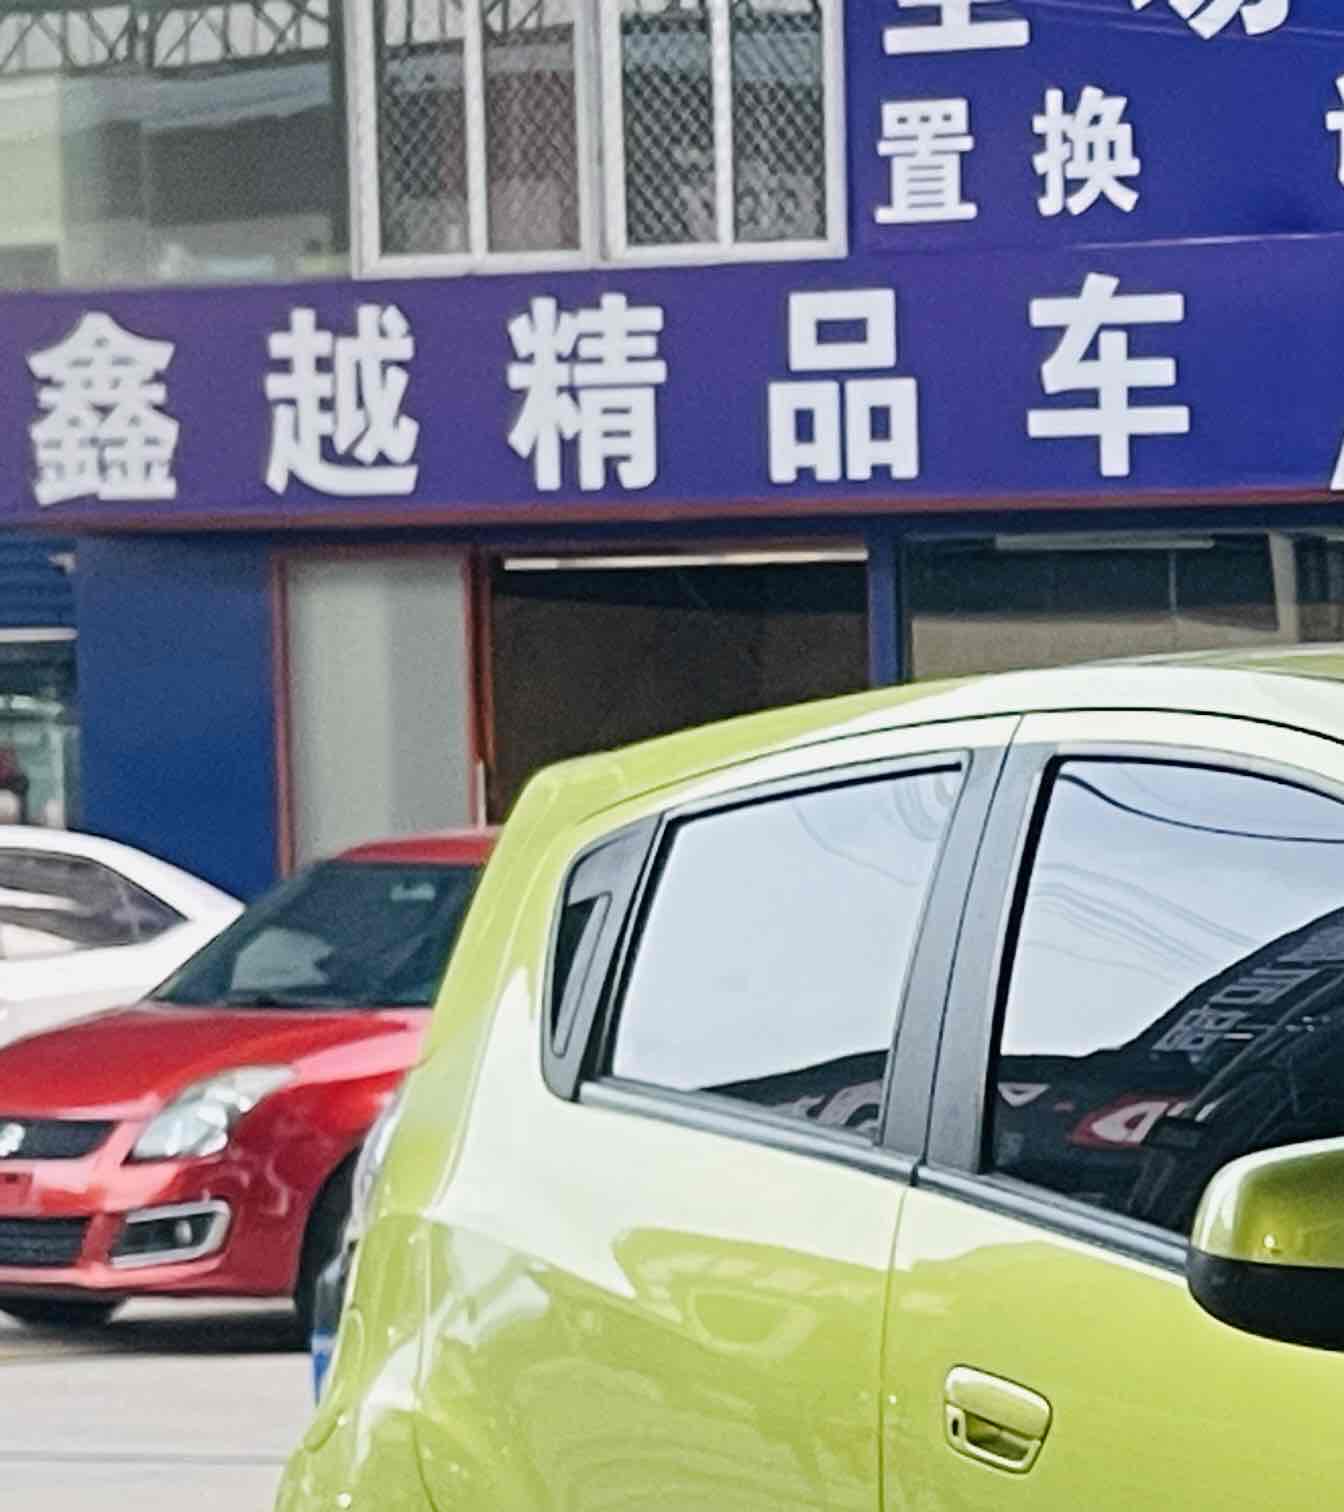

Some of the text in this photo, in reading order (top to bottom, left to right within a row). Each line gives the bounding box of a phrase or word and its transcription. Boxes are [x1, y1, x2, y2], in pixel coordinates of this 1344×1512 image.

[875, 86, 1141, 224] 置换
[28, 272, 1190, 506] 鑫越精品车
